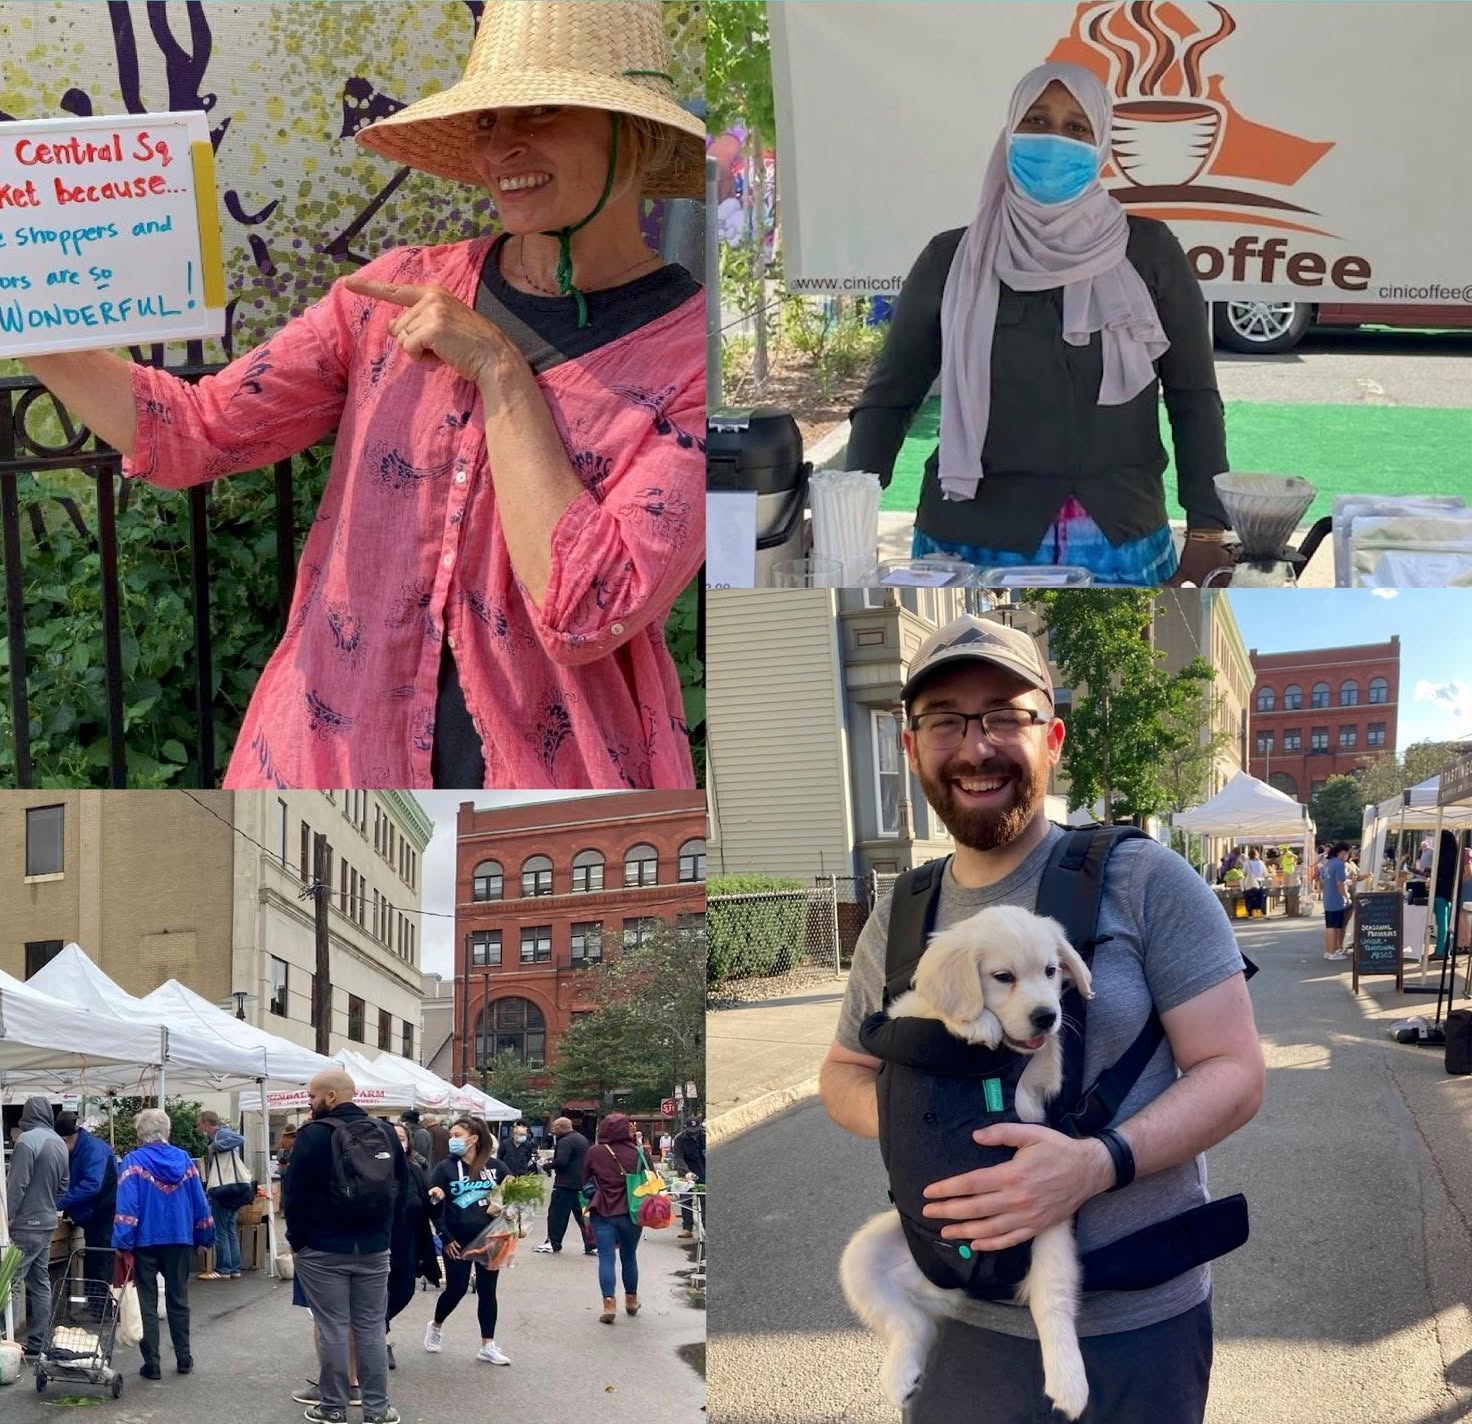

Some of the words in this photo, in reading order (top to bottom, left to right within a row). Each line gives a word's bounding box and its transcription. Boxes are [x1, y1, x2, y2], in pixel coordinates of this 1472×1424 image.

[14, 134, 123, 166] Central
[132, 131, 173, 168] Sq
[53, 174, 188, 206] because...
[132, 215, 172, 237] and
[1186, 235, 1372, 291] offee
[46, 269, 80, 286] are
[797, 275, 904, 290] www.cinicoff
